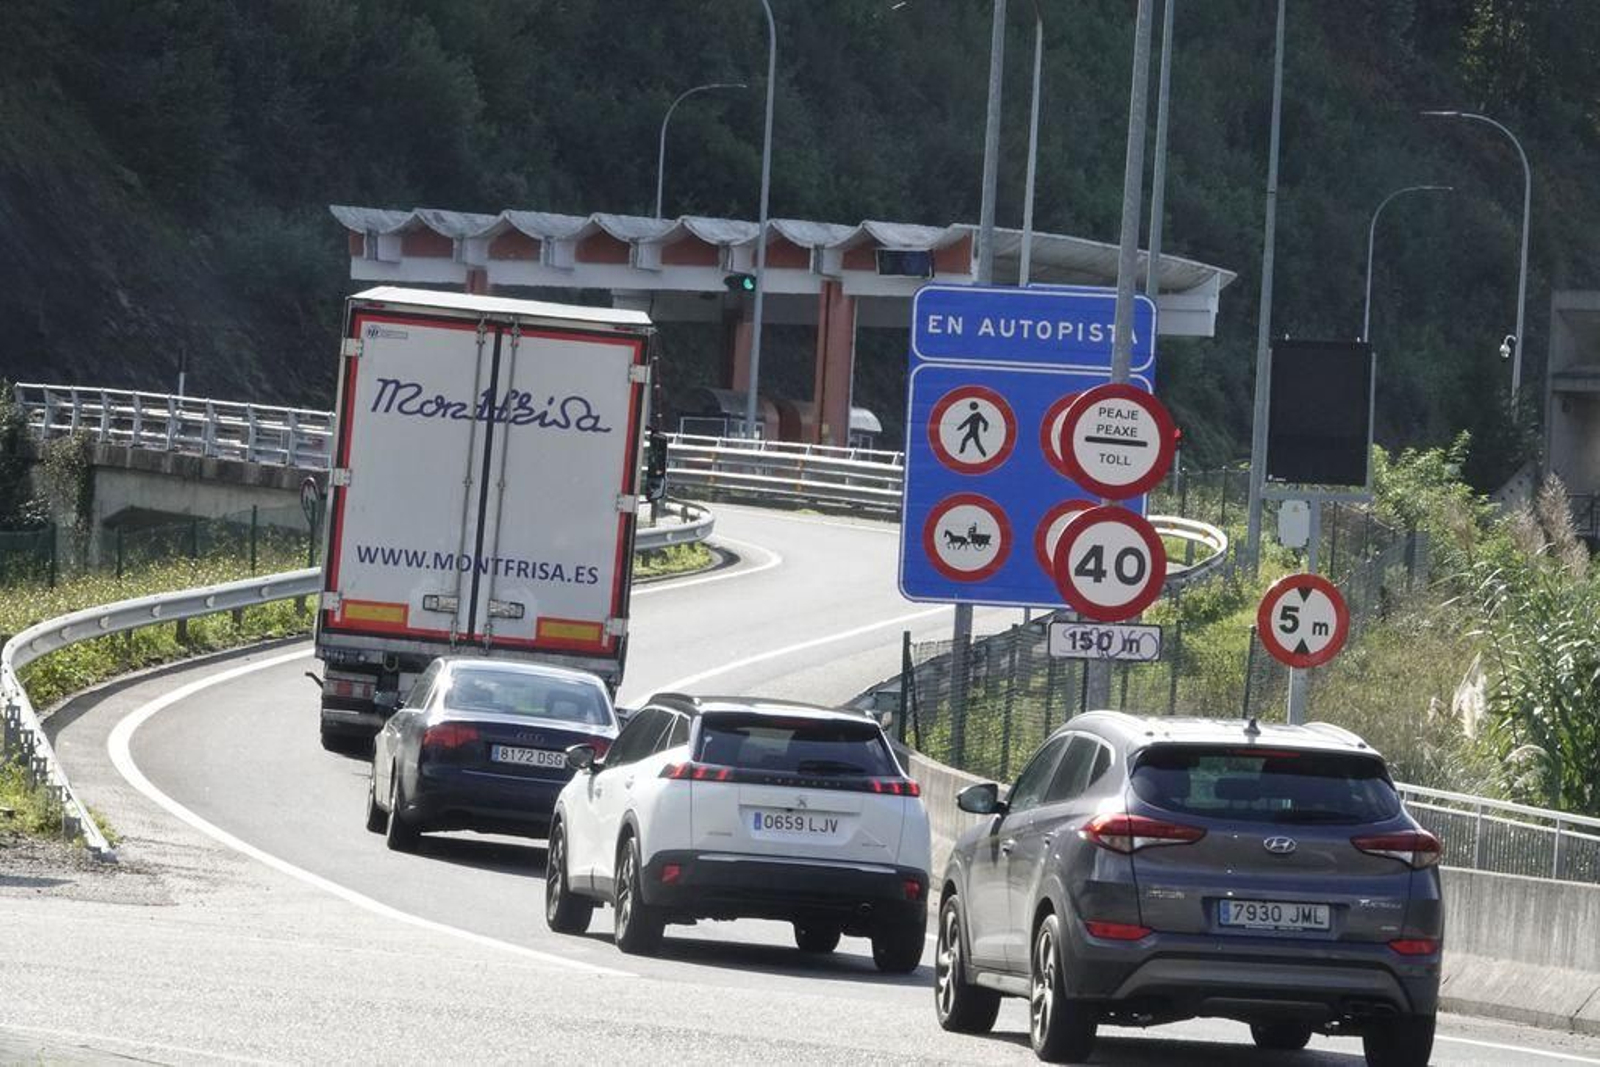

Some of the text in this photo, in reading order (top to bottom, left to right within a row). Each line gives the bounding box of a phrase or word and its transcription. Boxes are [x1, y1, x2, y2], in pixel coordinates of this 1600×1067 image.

[927, 315, 963, 335] EN
[1098, 407, 1139, 420] PEAJE
[1096, 424, 1138, 438] PEAXE
[1099, 453, 1131, 466] TOLL
[356, 545, 599, 585] WWW.MONTFRISA.ES
[1074, 544, 1147, 586] 40
[1278, 606, 1329, 636] 5 m
[1069, 630, 1141, 653] 150 m
[500, 748, 534, 763] 8172
[764, 814, 838, 833] 0659 LJV
[1233, 904, 1325, 925] 7930 JML
